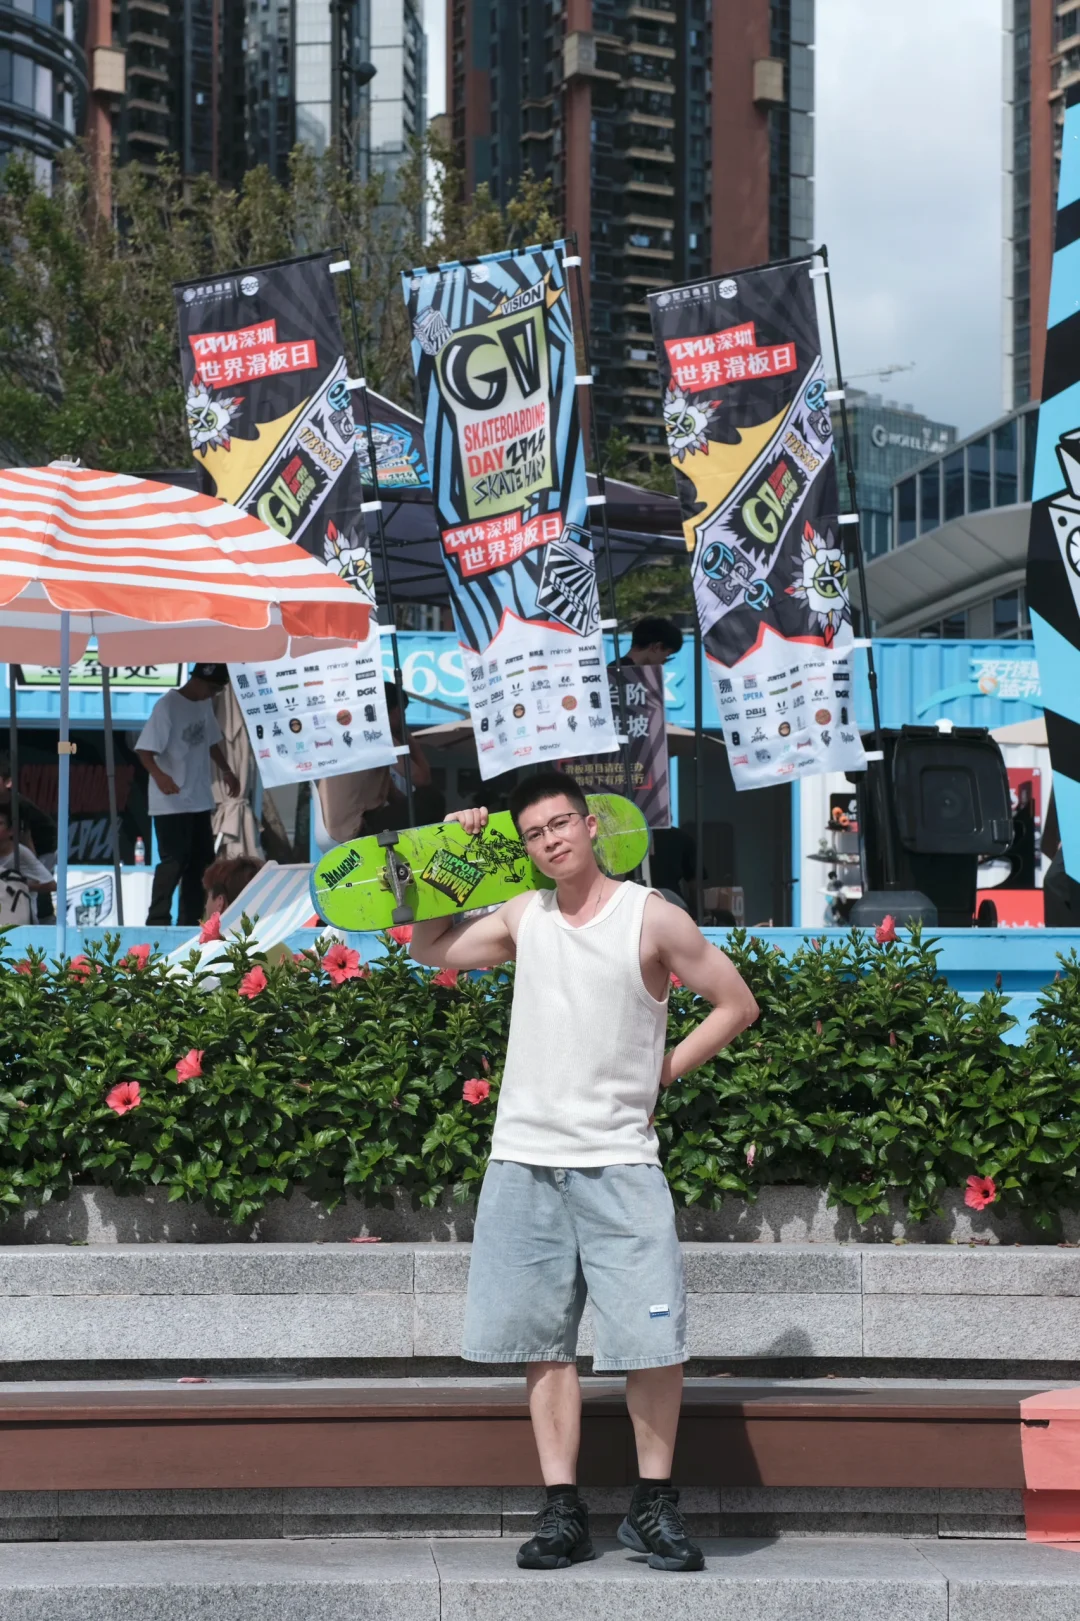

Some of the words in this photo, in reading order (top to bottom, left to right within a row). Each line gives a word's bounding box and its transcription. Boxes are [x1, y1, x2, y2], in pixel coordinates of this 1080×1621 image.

[503, 286, 541, 314] VISION
[198, 343, 310, 382] 世界滑板日
[440, 316, 541, 411] GV
[673, 347, 791, 386] 世界滑板日
[463, 402, 546, 453] SKATEBOARDING
[467, 446, 505, 478] DAY
[471, 468, 523, 506] SKATE
[742, 480, 786, 544] GV
[461, 518, 562, 572] 世界滑板日
[357, 686, 378, 697] DGK
[581, 675, 602, 684] DGK
[743, 691, 764, 701] OPERA
[720, 696, 737, 705] SAGA
[454, 869, 479, 886] LOCAL
